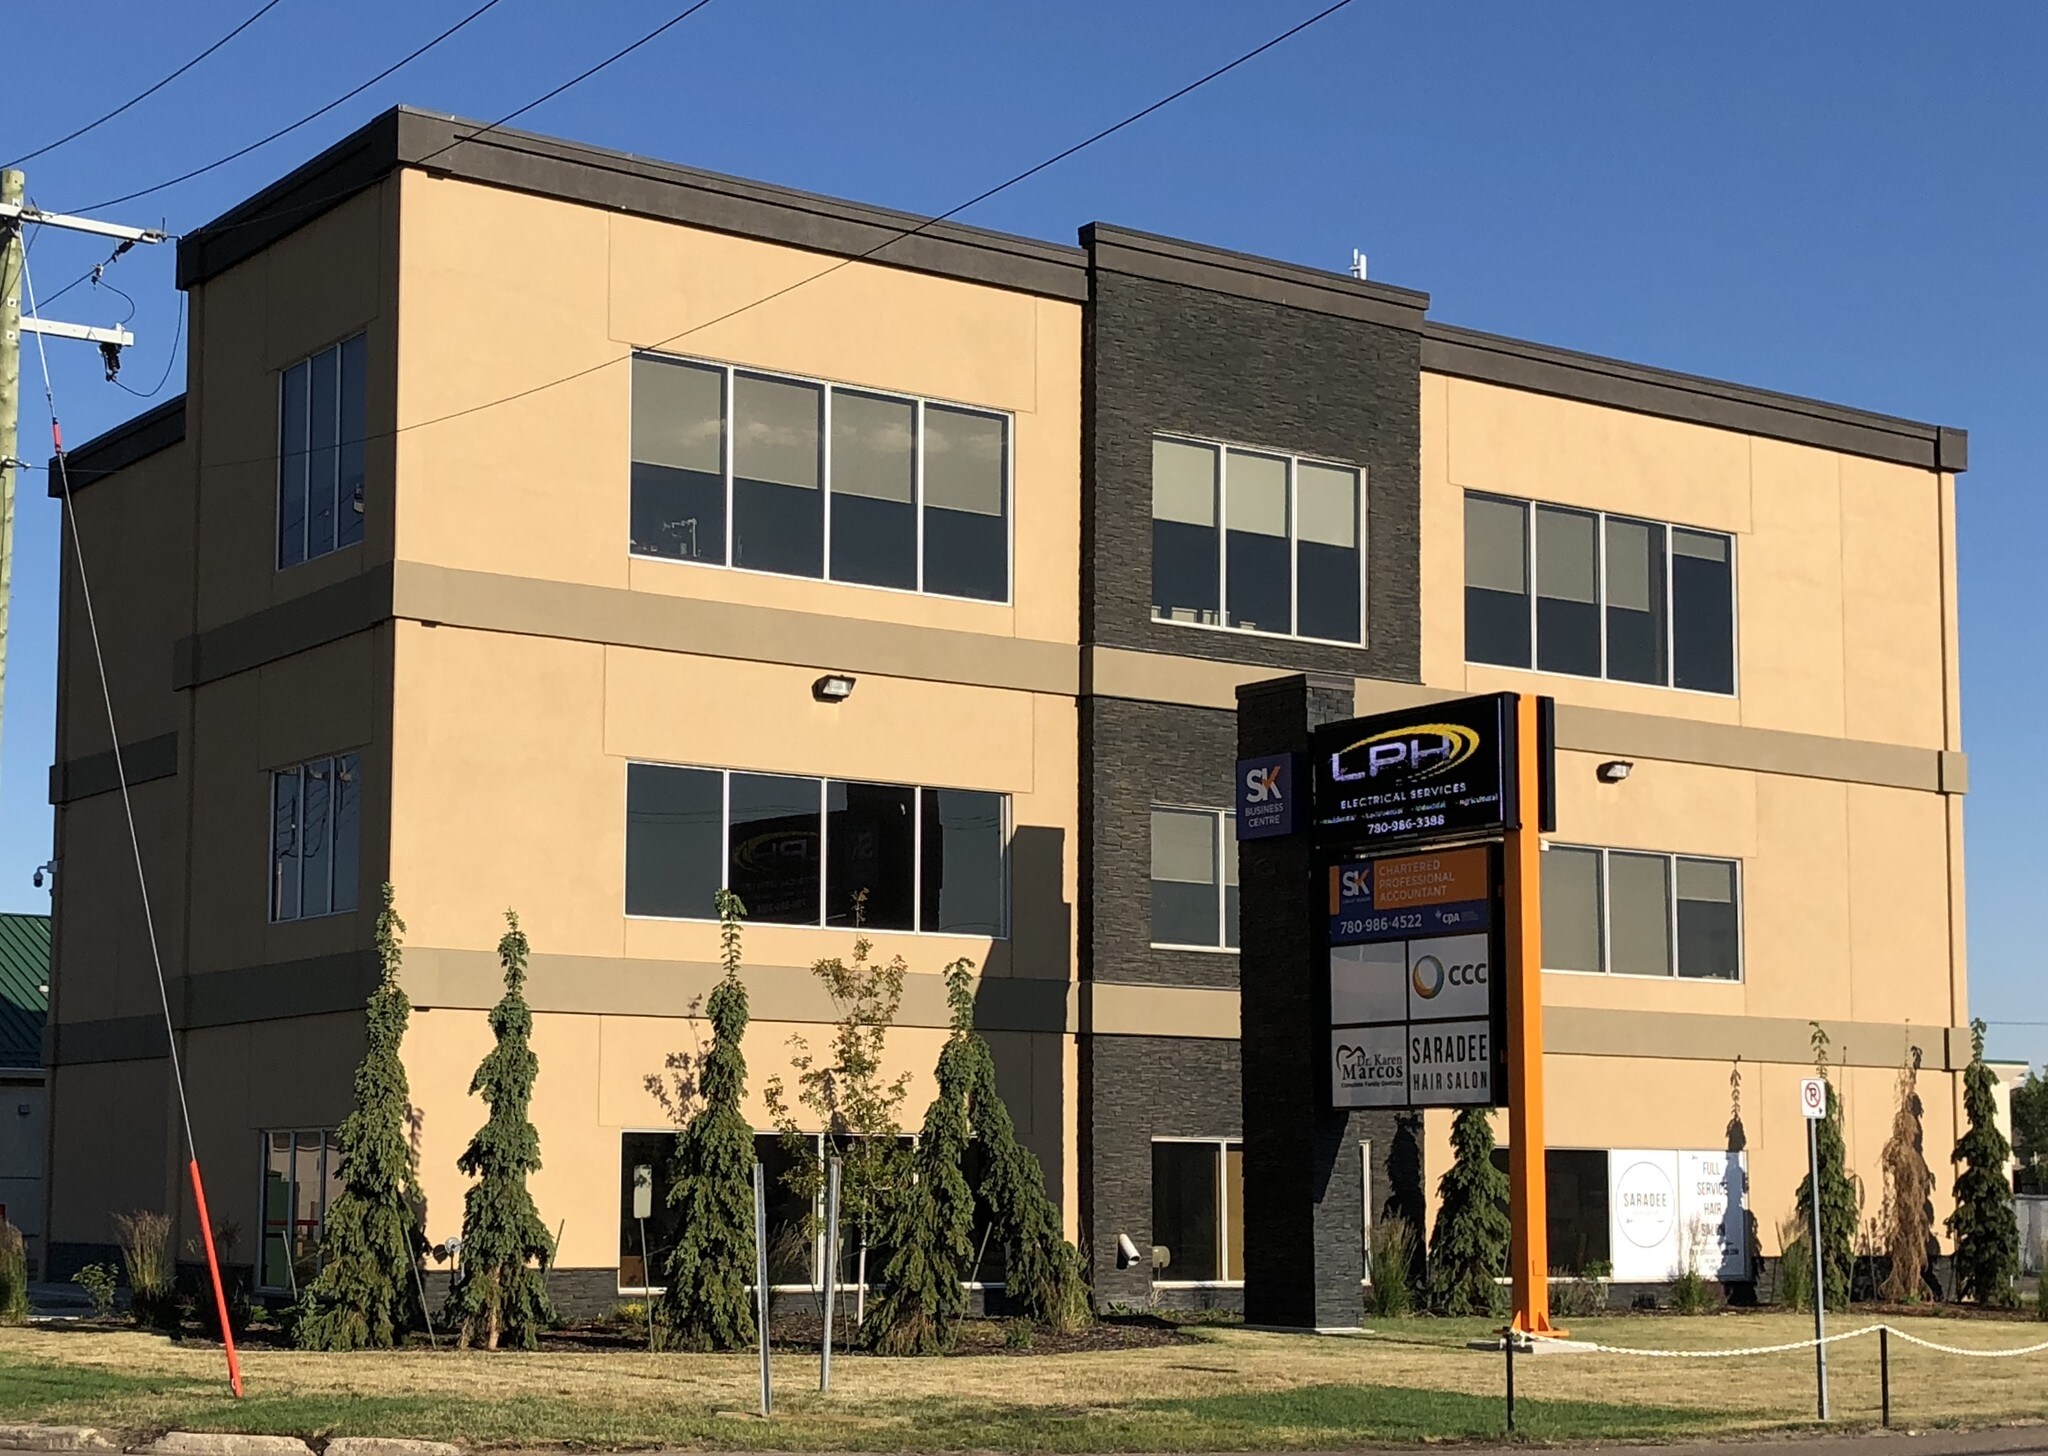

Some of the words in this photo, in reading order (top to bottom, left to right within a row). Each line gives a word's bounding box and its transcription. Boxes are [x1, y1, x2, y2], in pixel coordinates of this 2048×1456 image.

[1331, 736, 1450, 781] LPH
[1246, 765, 1282, 803] SK
[1340, 791, 1406, 810] ELECTRICAL
[1410, 783, 1467, 800] SERVICES
[1245, 803, 1284, 816] BUSINESS
[1248, 815, 1280, 827] CENTRE
[1379, 860, 1440, 876] CHARTERED
[1342, 869, 1370, 896] SK
[1379, 872, 1455, 889] PROFESSIONAL
[1379, 885, 1448, 902] ACCOUNTANT
[1448, 963, 1487, 986] CCC
[1412, 1034, 1487, 1064] SARADEE
[1357, 1055, 1370, 1067] Dr.
[1374, 1054, 1403, 1066] Karen
[1342, 1063, 1403, 1080] Marcos
[1413, 1072, 1442, 1091] HAIR
[1447, 1071, 1487, 1090] SALON
[1702, 1161, 1720, 1175] FULL
[1623, 1193, 1667, 1208] SARADEE
[1703, 1202, 1722, 1216] HAIR
